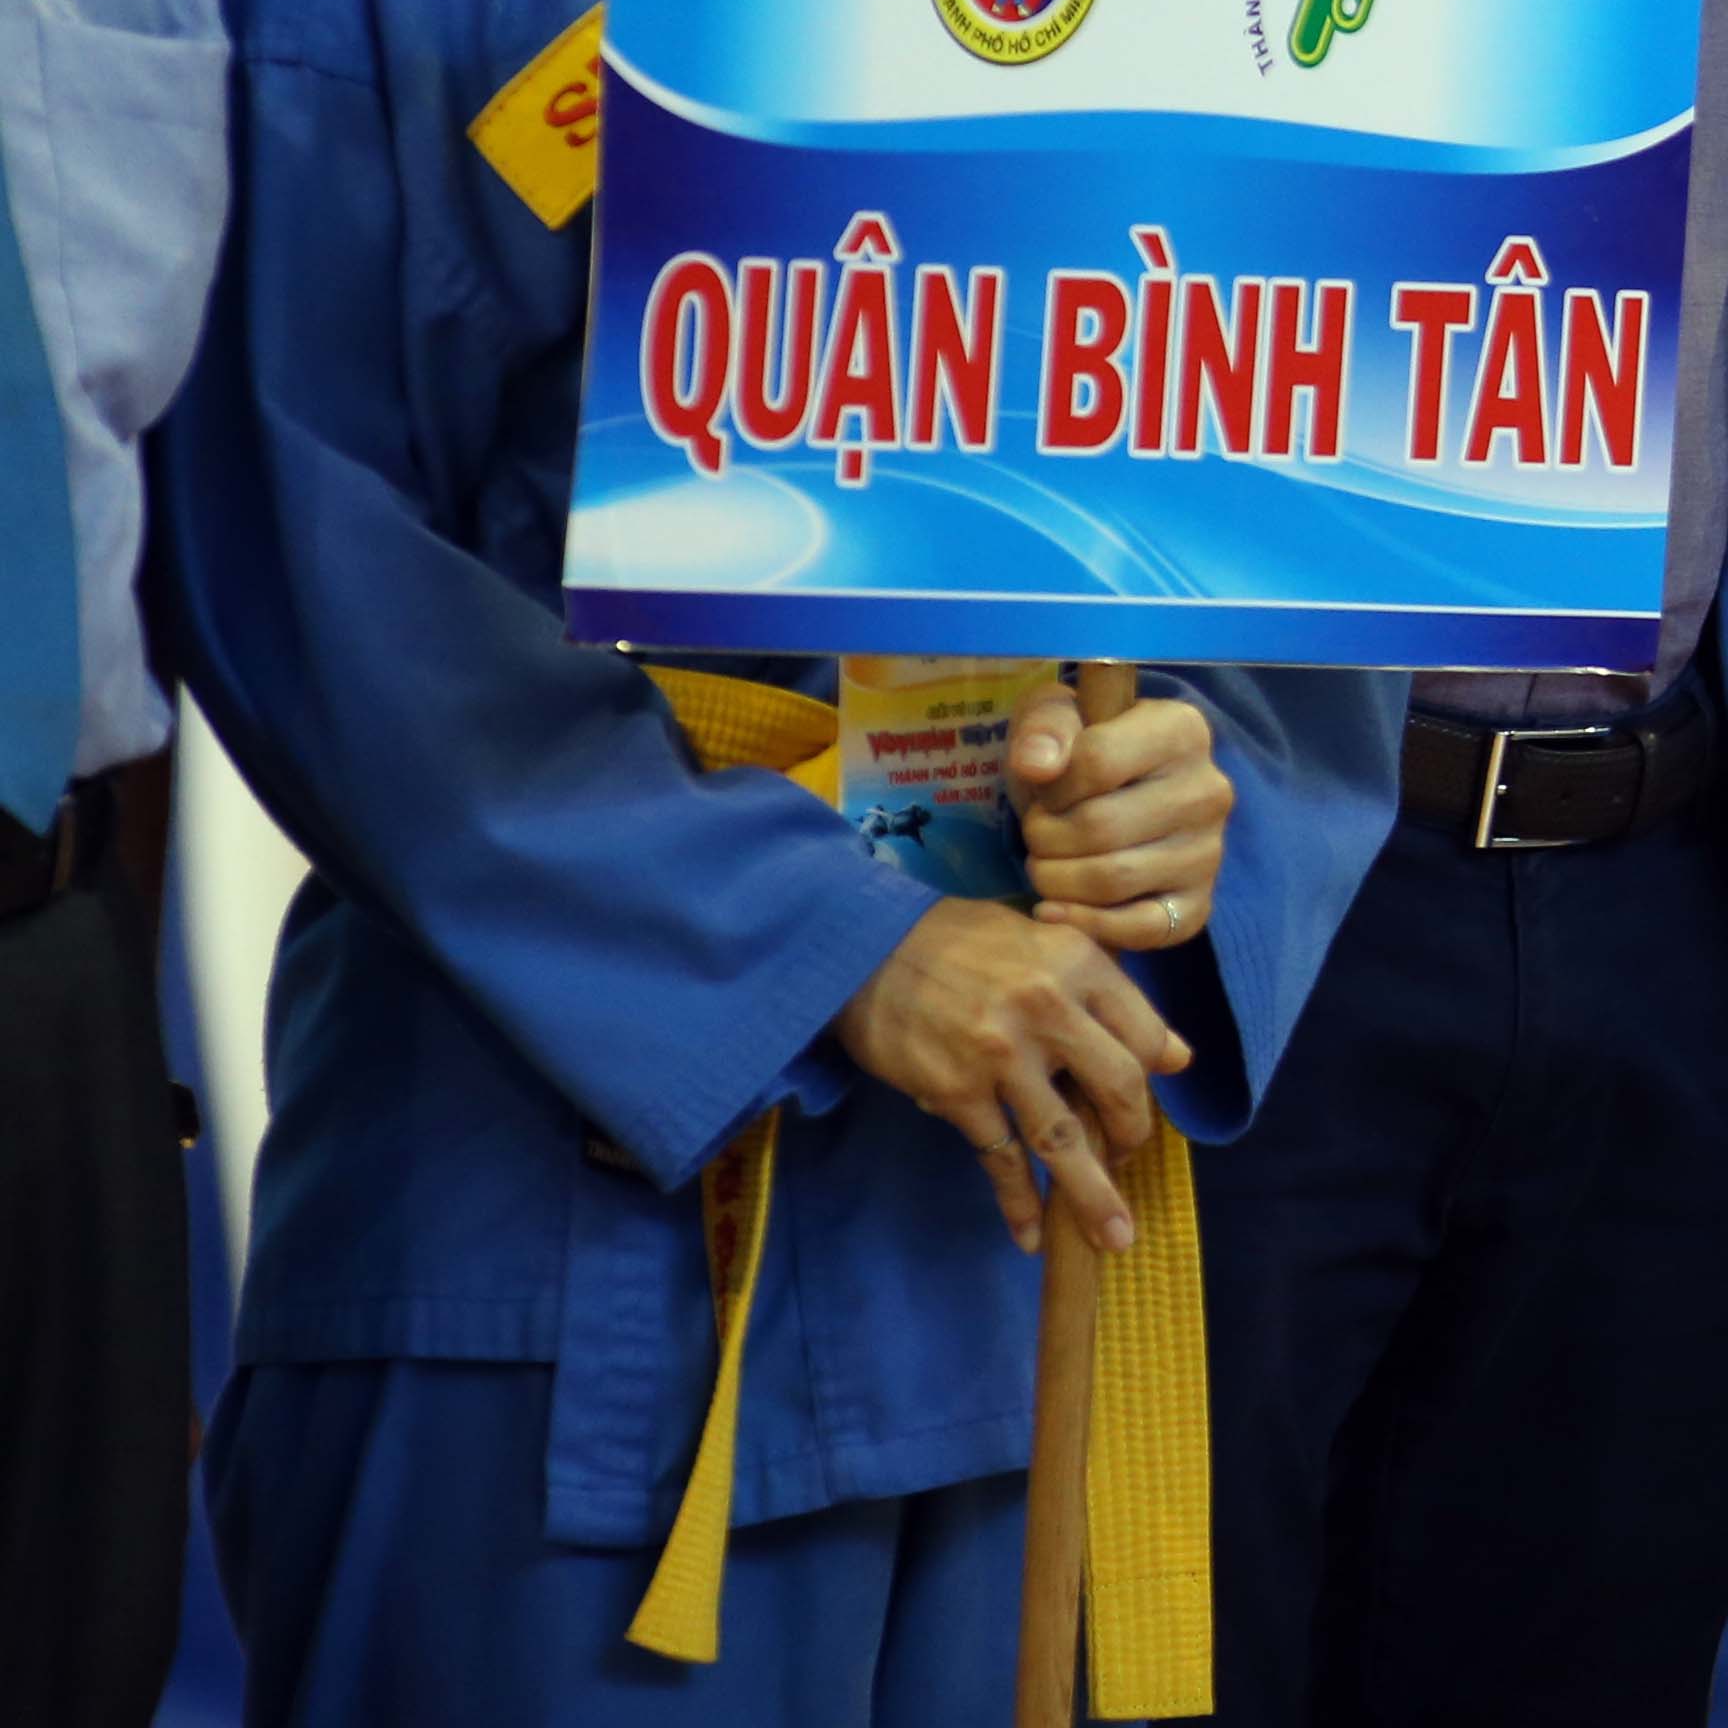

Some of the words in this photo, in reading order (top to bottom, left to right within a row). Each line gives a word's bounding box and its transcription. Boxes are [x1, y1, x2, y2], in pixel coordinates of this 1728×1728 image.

[972, 30, 1004, 53] PHỐ
[1008, 31, 1030, 54] HỒ
[1035, 20, 1062, 47] CHÍ
[647, 216, 1000, 483] QUẬN
[1043, 229, 1351, 461] BÌNH
[1394, 239, 1648, 470] TÂN
